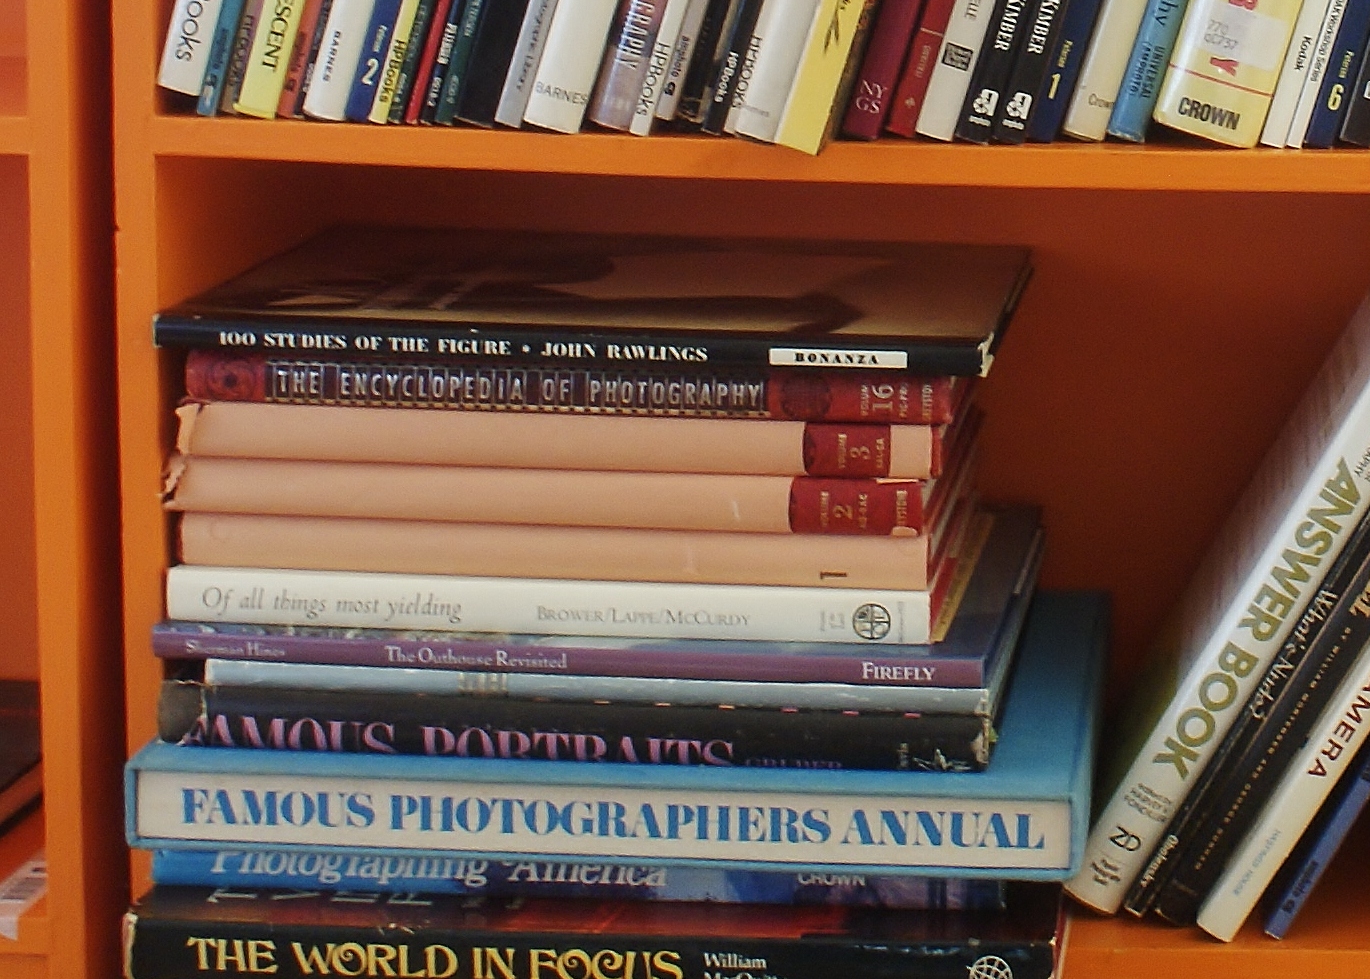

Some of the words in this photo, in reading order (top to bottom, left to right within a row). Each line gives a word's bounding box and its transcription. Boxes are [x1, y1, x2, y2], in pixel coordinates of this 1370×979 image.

[1178, 97, 1241, 130] CROWN
[218, 329, 256, 347] 100
[263, 331, 346, 350] STUDIES
[355, 334, 382, 352] OF
[388, 335, 430, 353] THE
[438, 337, 510, 357] FIGURE
[540, 340, 596, 359] JOHN
[606, 343, 708, 364] RAWLINGS
[793, 349, 880, 367] BONANZA
[202, 585, 235, 616] Of
[238, 587, 264, 611] all
[273, 588, 328, 619] things
[336, 594, 379, 616] most
[386, 592, 461, 625] yielding
[861, 660, 935, 683] FIREFLY
[1151, 639, 1262, 784] BOOK
[181, 786, 377, 831] FAMOUS
[387, 792, 832, 845] PHOTOGRAPHERS
[841, 806, 1045, 852] ANNUAL
[186, 938, 276, 974] THE
[291, 941, 458, 979] WORLD
[472, 946, 516, 979] IN
[528, 948, 683, 979] FOCUS
